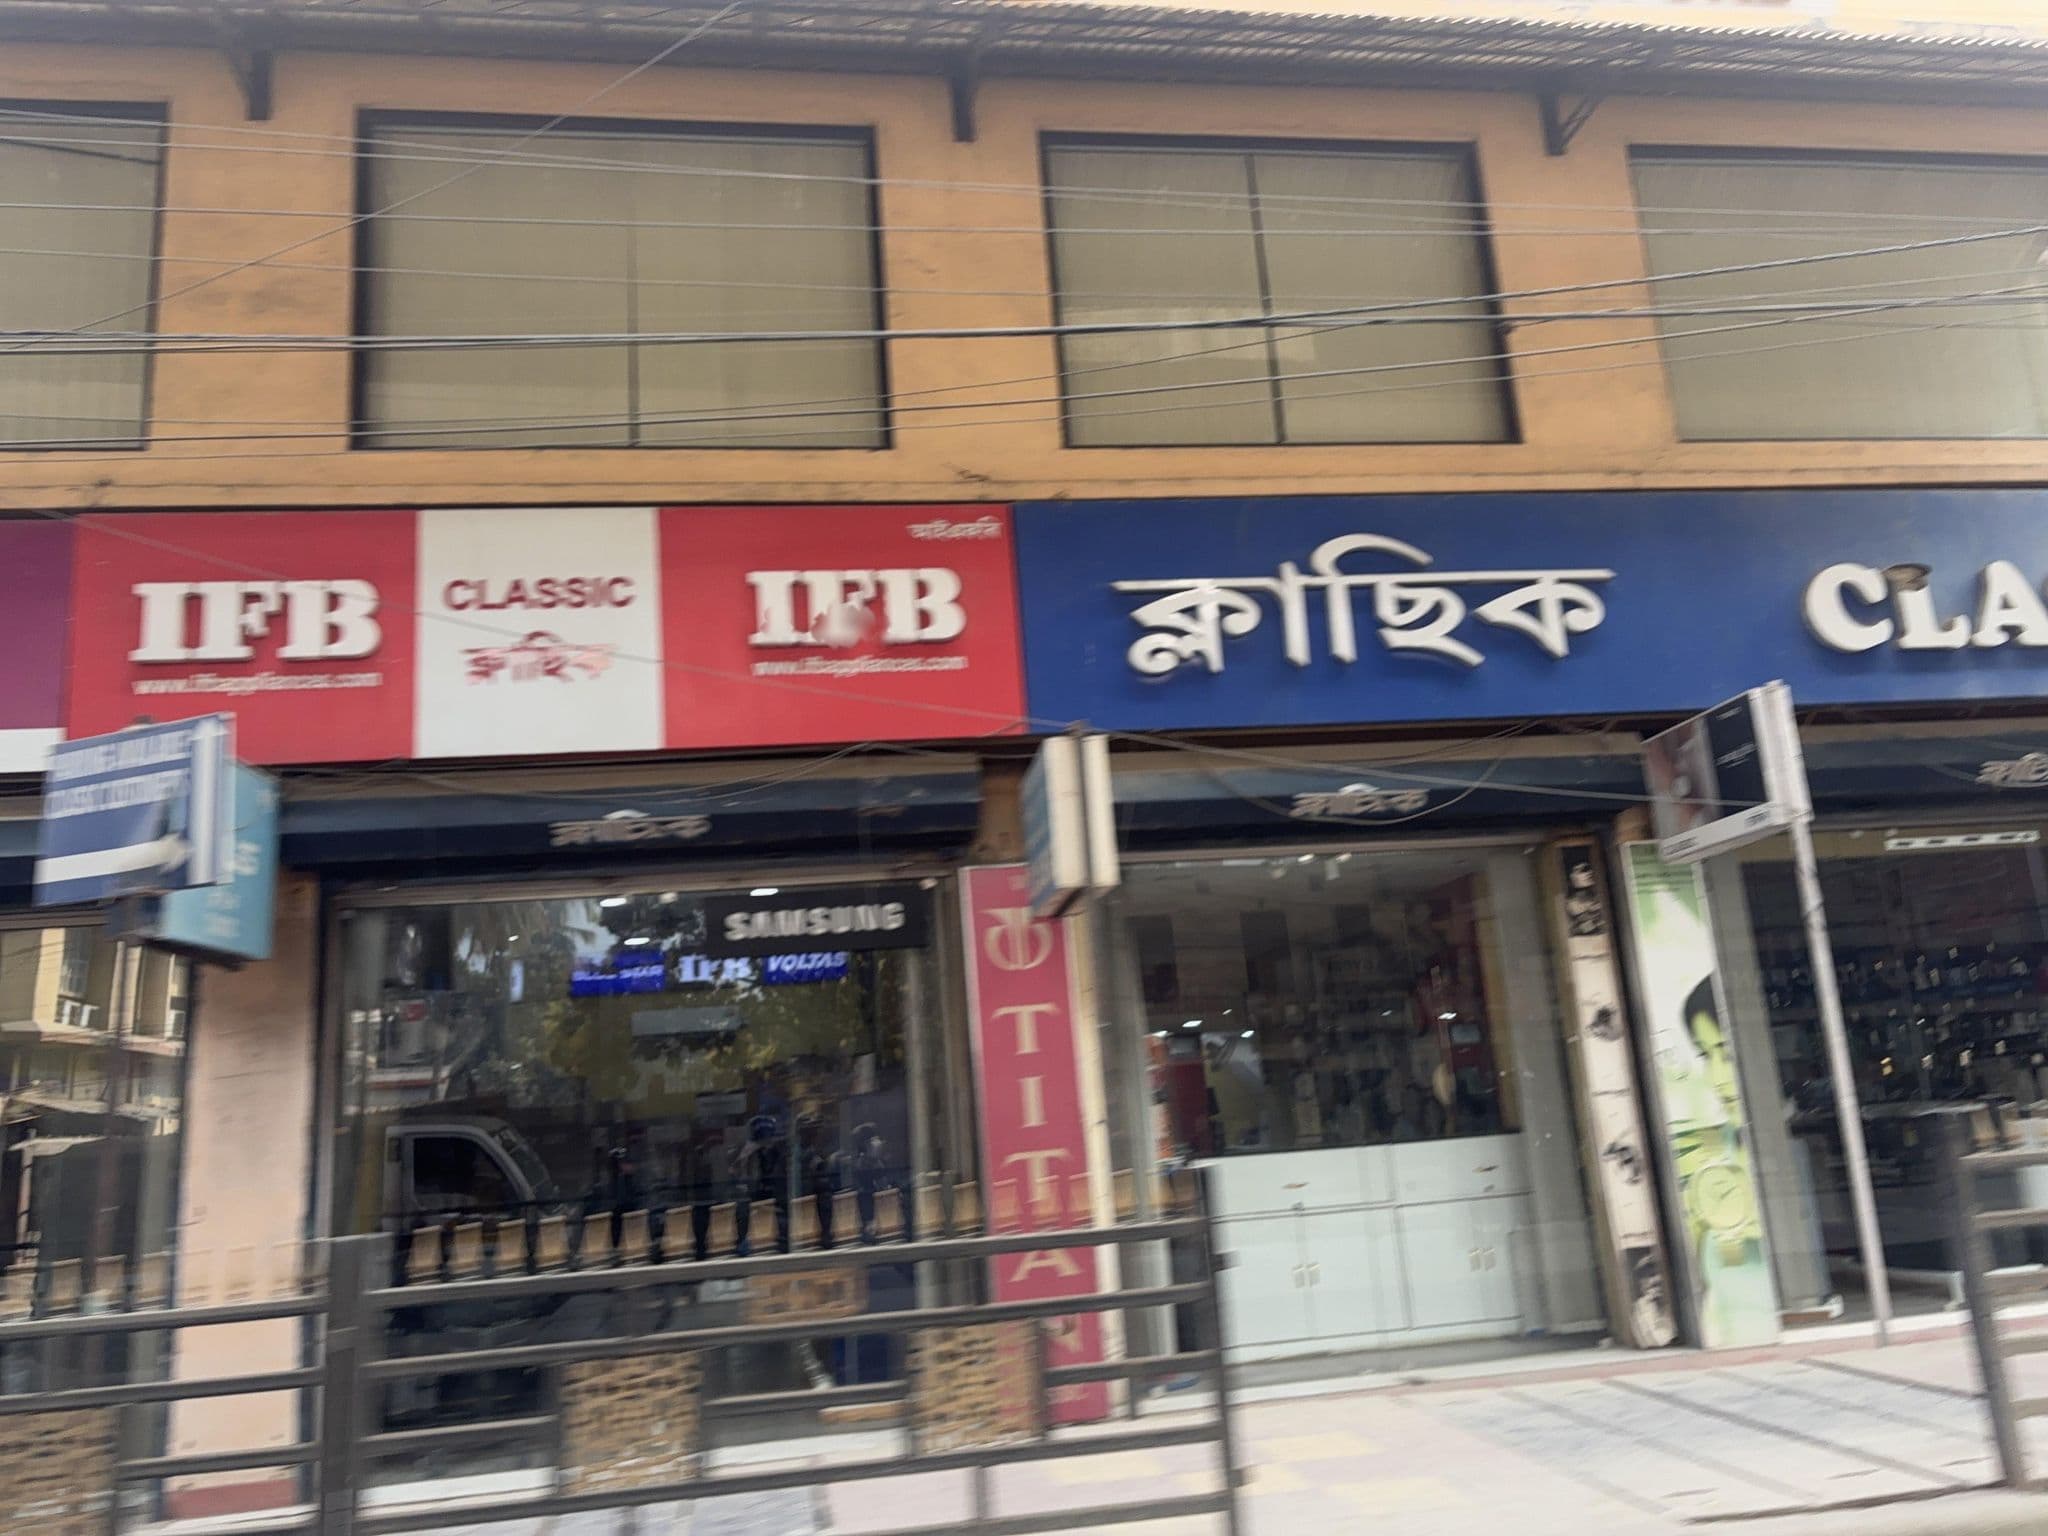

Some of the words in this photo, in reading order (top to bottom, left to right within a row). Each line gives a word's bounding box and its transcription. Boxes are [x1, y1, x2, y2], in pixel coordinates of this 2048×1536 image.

[128, 579, 381, 661] IFB
[443, 577, 638, 611] CLASSIC
[746, 568, 966, 647] IFB
[1110, 533, 1617, 674] ক্লাছিক
[724, 903, 905, 941] SAMSUNG
[767, 951, 848, 972] VOLTAS
